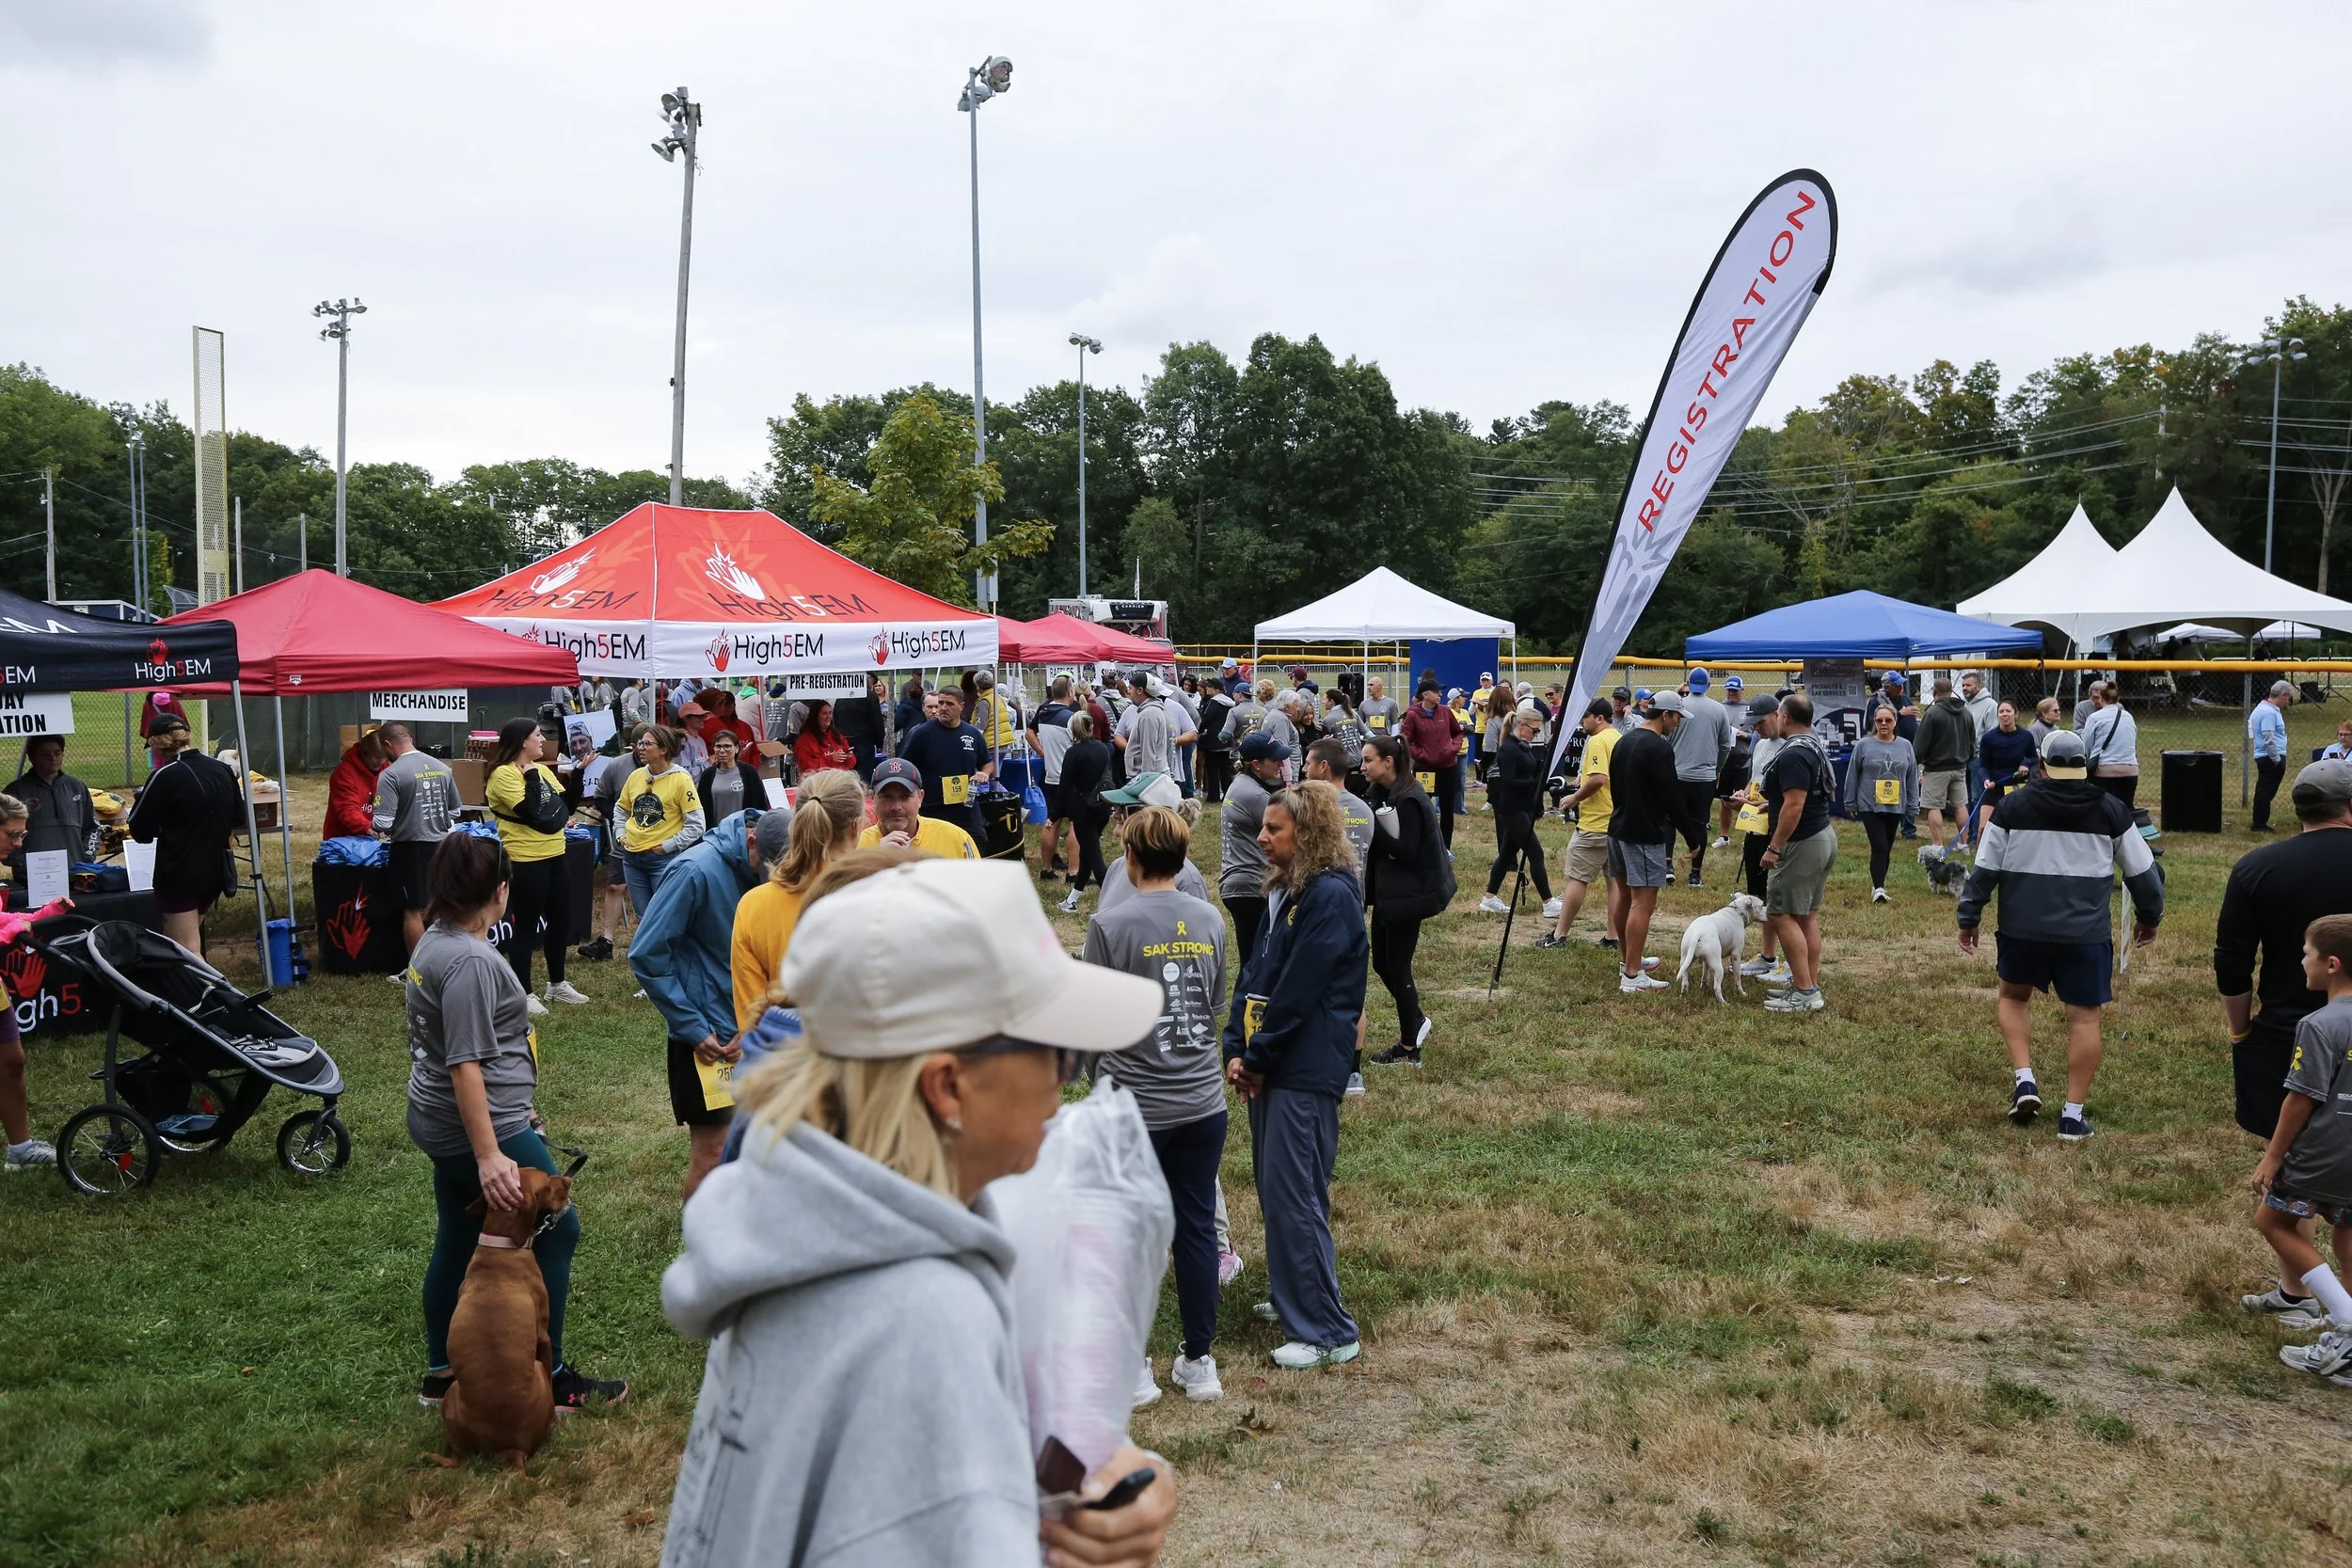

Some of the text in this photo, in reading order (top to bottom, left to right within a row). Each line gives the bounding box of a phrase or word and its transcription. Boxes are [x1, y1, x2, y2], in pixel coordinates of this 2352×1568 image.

[1637, 190, 1816, 532] REGISTRATION
[477, 590, 639, 611] High5EM
[707, 593, 880, 621] High5EM
[734, 633, 824, 665] High5EM
[891, 629, 965, 658] High5EM
[135, 658, 212, 683] High5EM
[789, 674, 865, 689] PRE-REGISTRATION
[372, 692, 466, 710] MERCHANDISE
[1343, 816, 1369, 826] TRONG
[1143, 942, 1215, 958] SAK STRONG
